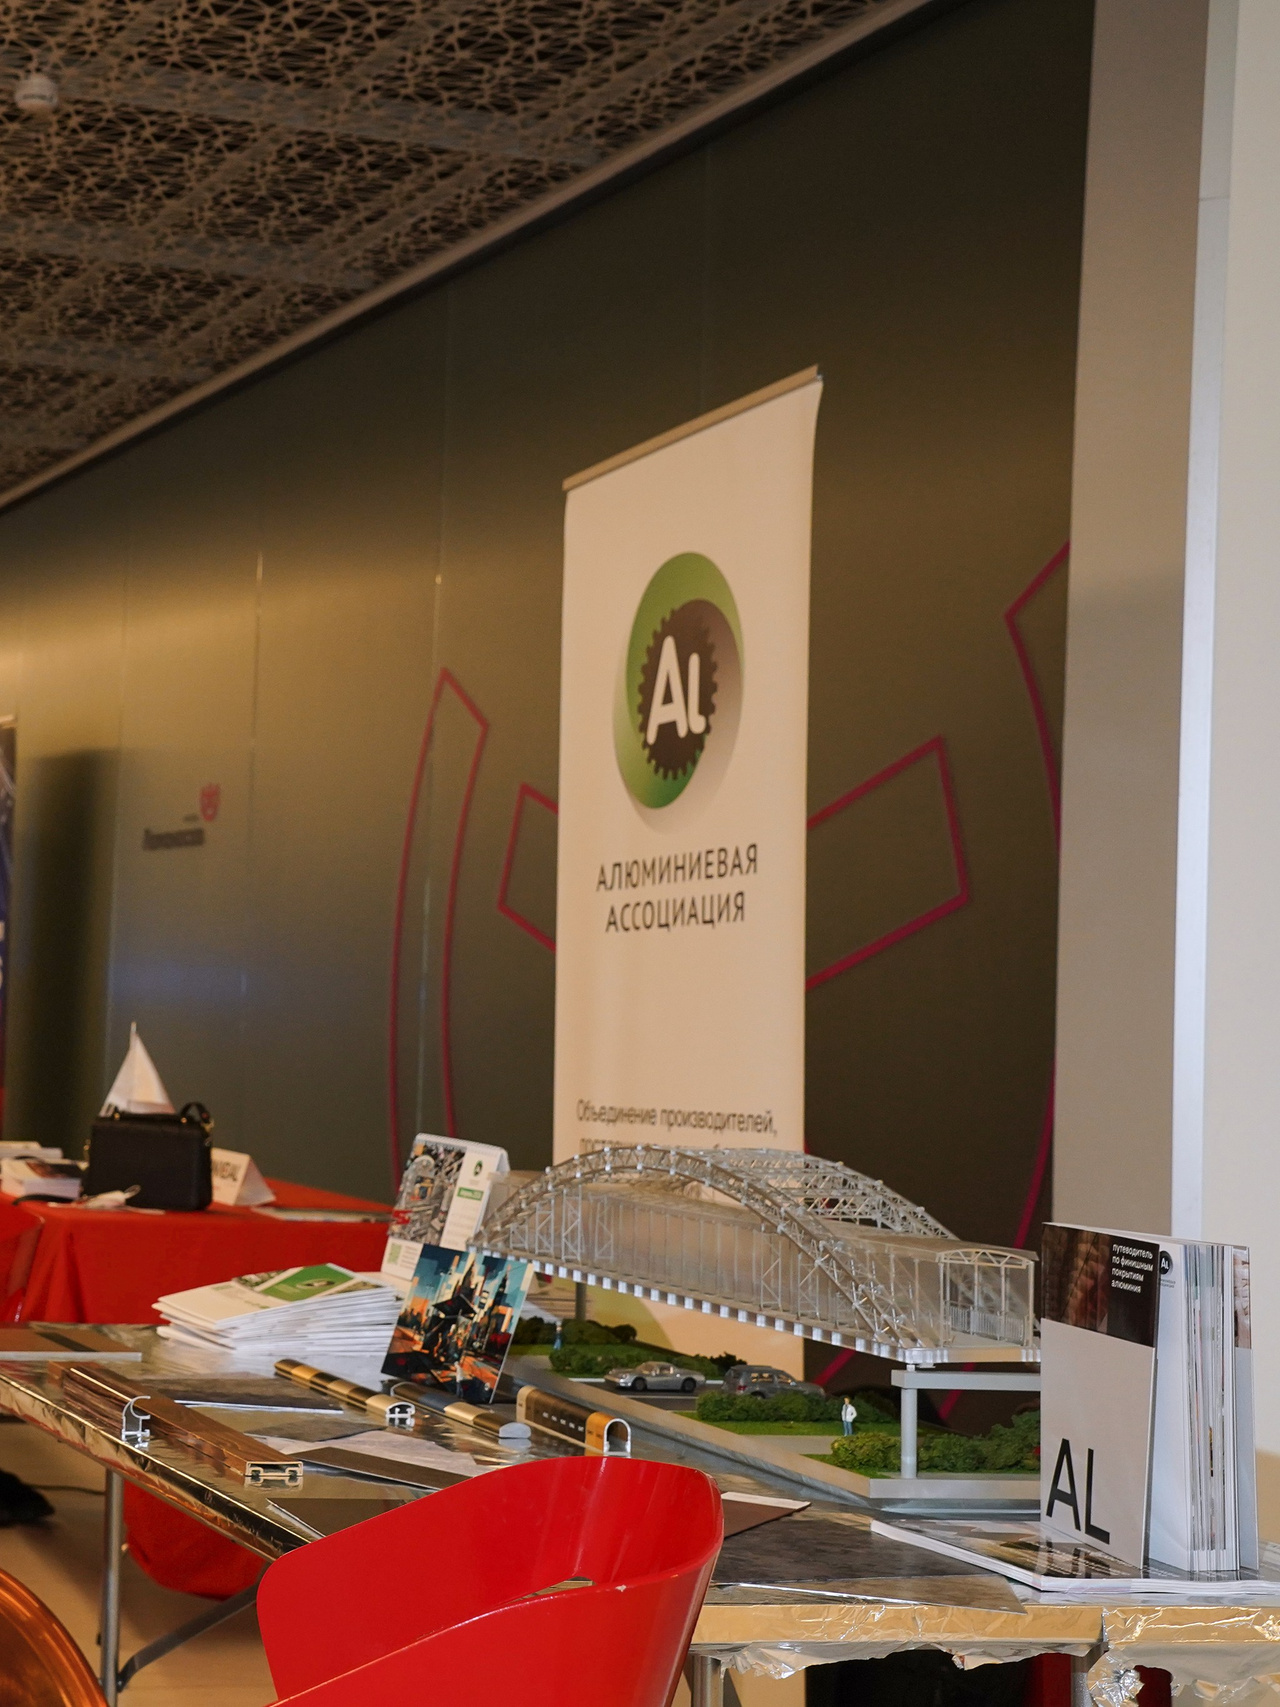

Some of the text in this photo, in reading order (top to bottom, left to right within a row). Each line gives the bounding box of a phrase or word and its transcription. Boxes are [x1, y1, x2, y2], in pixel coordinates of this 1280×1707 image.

[596, 843, 758, 892] АЛЮМИНИЕВАЯ
[605, 891, 746, 933] АССОЦИАЦИЯ
[576, 1099, 657, 1127] Объединение
[1112, 1244, 1153, 1259] путеводитель
[1112, 1256, 1153, 1271] по финишным
[1111, 1268, 1144, 1281] покрытиям
[1111, 1280, 1141, 1293] алюминия
[1046, 1438, 1111, 1546] AL
